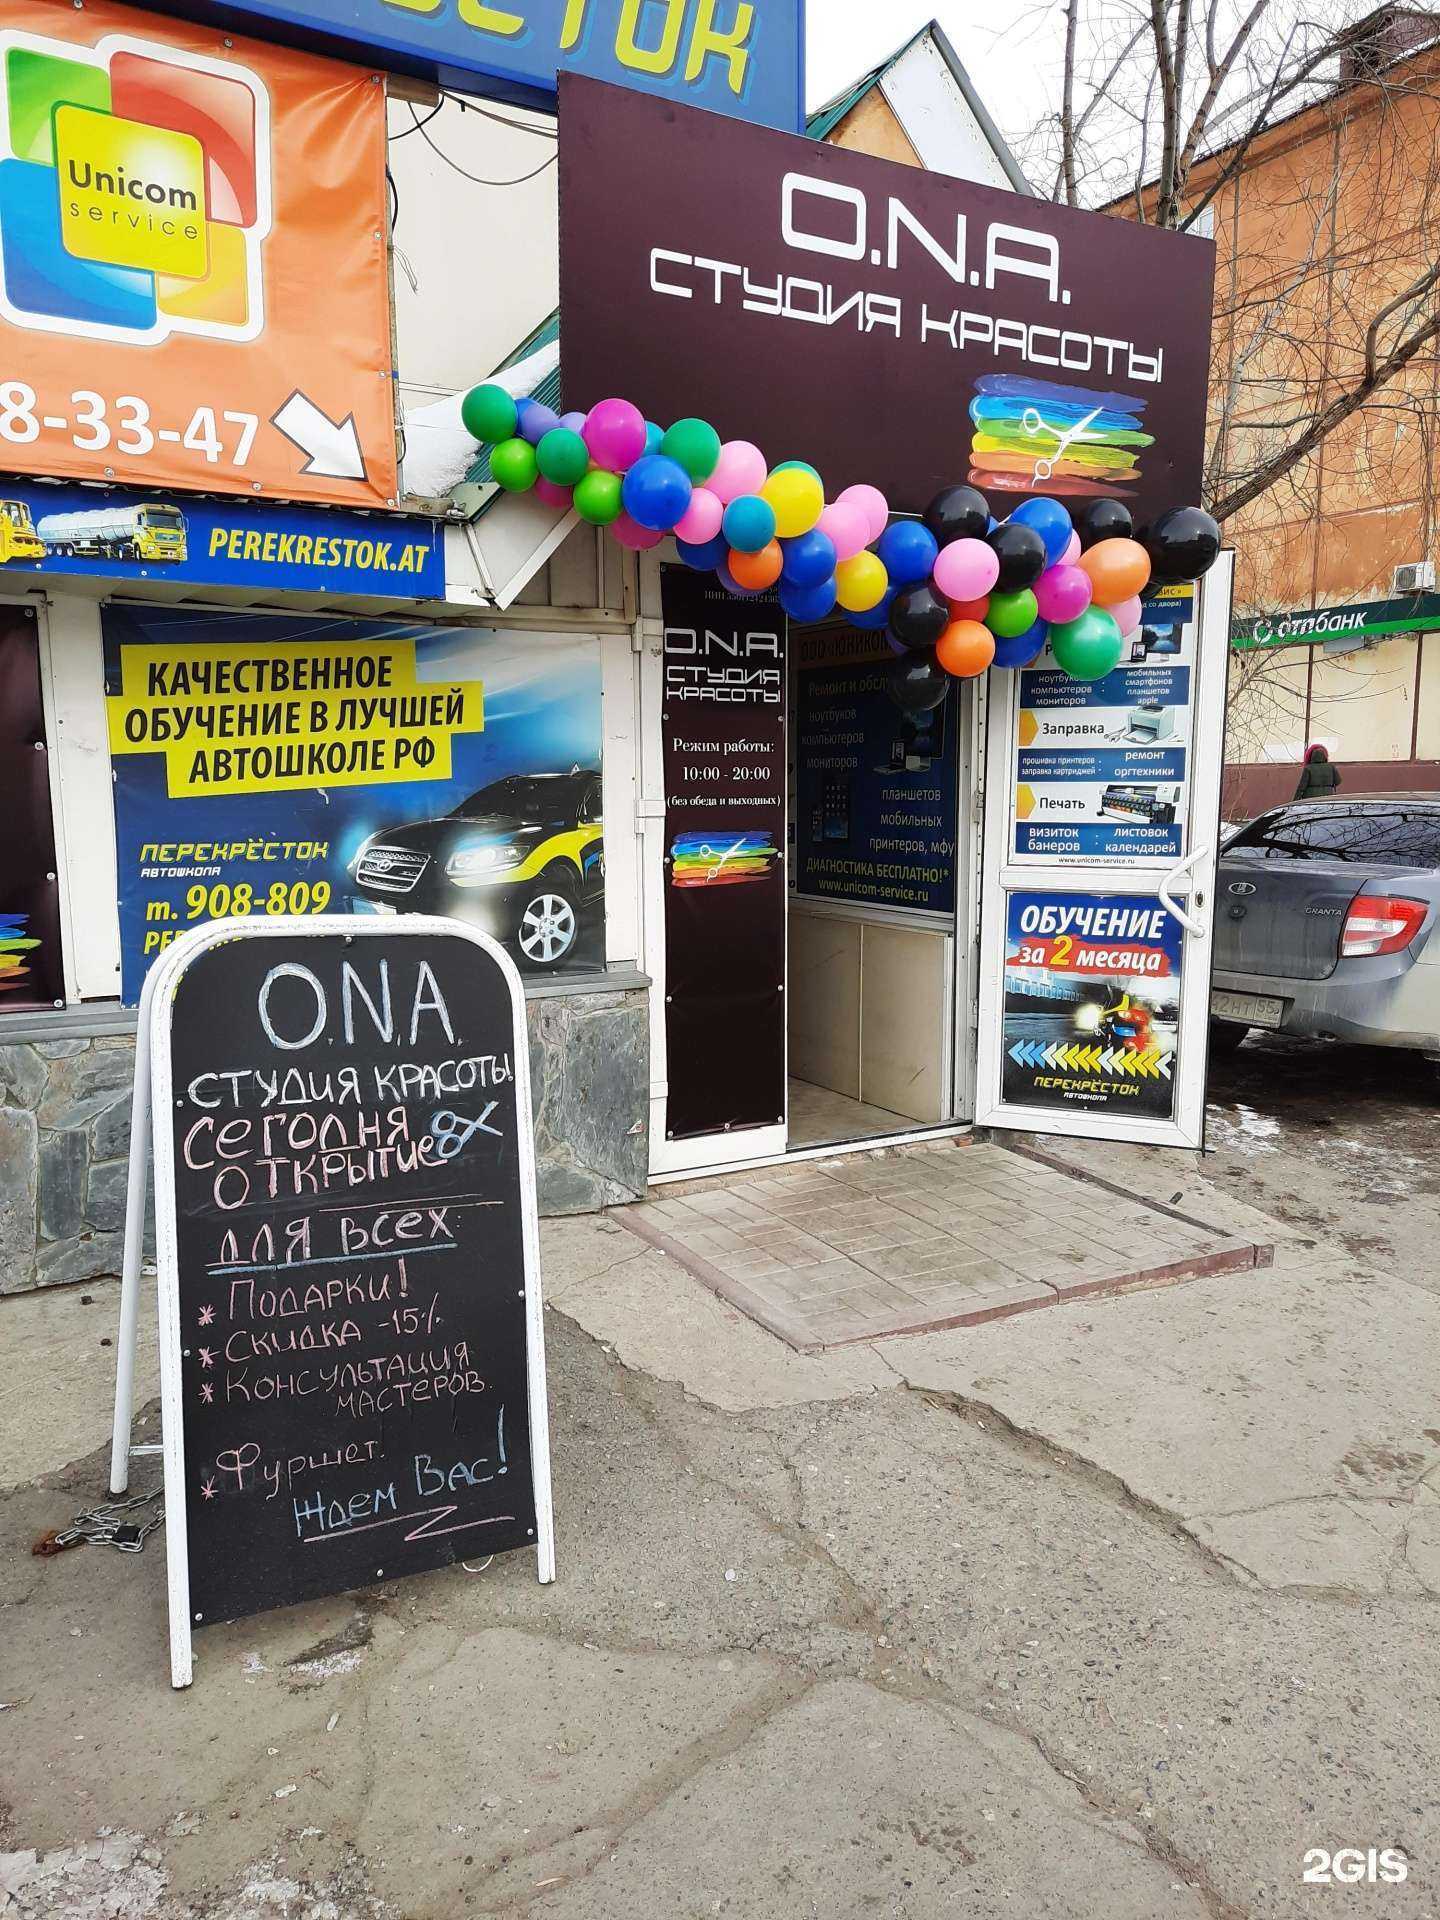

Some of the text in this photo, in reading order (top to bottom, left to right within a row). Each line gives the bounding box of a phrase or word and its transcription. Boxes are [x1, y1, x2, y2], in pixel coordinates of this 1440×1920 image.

[68, 159, 197, 211] Unicom
[70, 201, 198, 240] service
[650, 247, 1163, 383] СТУДИЯ КРАСОТЫ
[0, 381, 259, 466] 8-33-47
[209, 528, 430, 573] PEREKRESTOK.AT
[148, 656, 393, 697] КАЧЕСТВЕННОЕ
[666, 665, 780, 685] СТУДИЯ
[1126, 668, 1172, 677] мобильных
[808, 679, 847, 696] Ремонт
[1031, 686, 1093, 695] компьютеров
[1125, 678, 1173, 687] смартфонов
[666, 686, 781, 702] КРАСОТЫ
[1126, 687, 1170, 695] планшетов
[1035, 697, 1086, 706] мониторов
[1137, 696, 1159, 705] apple
[125, 688, 464, 743] ОБУЧЕНИЕ В ЛУЧШЕЙ
[808, 707, 857, 724] ноутбуков
[1042, 722, 1105, 738] Заправка
[673, 737, 775, 756] Режим работы:
[801, 731, 865, 748] компьютеров
[189, 735, 436, 783] АВТОШКОЛЕ РФ
[806, 756, 859, 770] мониторов
[1022, 756, 1095, 766] прошивка принтеров
[1125, 750, 1165, 762] ремонт
[683, 766, 720, 781] 10:00
[732, 766, 771, 781] 20:00
[1021, 767, 1096, 776] заправка картриджей
[1114, 766, 1175, 778] оргтехники
[689, 795, 717, 807] обеда
[719, 797, 726, 806] и
[728, 795, 781, 809] выходных)
[882, 788, 941, 801] планшетов
[1039, 797, 1086, 810] Печать
[880, 810, 943, 828] мобильных
[1029, 828, 1079, 838] визиток
[1113, 828, 1169, 838] листовок
[140, 838, 329, 863] ПЕРЕКРЁСТОК
[869, 838, 955, 857] принтеров, мфу
[1028, 839, 1080, 853] банеров
[1105, 841, 1176, 854] календарей
[806, 857, 874, 877] ДИАГНОСТИКА
[1058, 857, 1136, 865] www.unicom-service.ru
[141, 866, 221, 878] АВТОШКОЛА
[818, 879, 929, 902] www.unicom-service.ru
[186, 881, 331, 919] 908-809
[1305, 907, 1342, 916] GRANTA
[1019, 905, 1167, 939] ОБУЧЕНИЕ
[1019, 935, 1162, 975] за 2 месяца
[187, 1065, 362, 1108] СТУДИЯ
[1033, 1076, 1140, 1096] ПЕРЕКРЁСТОК
